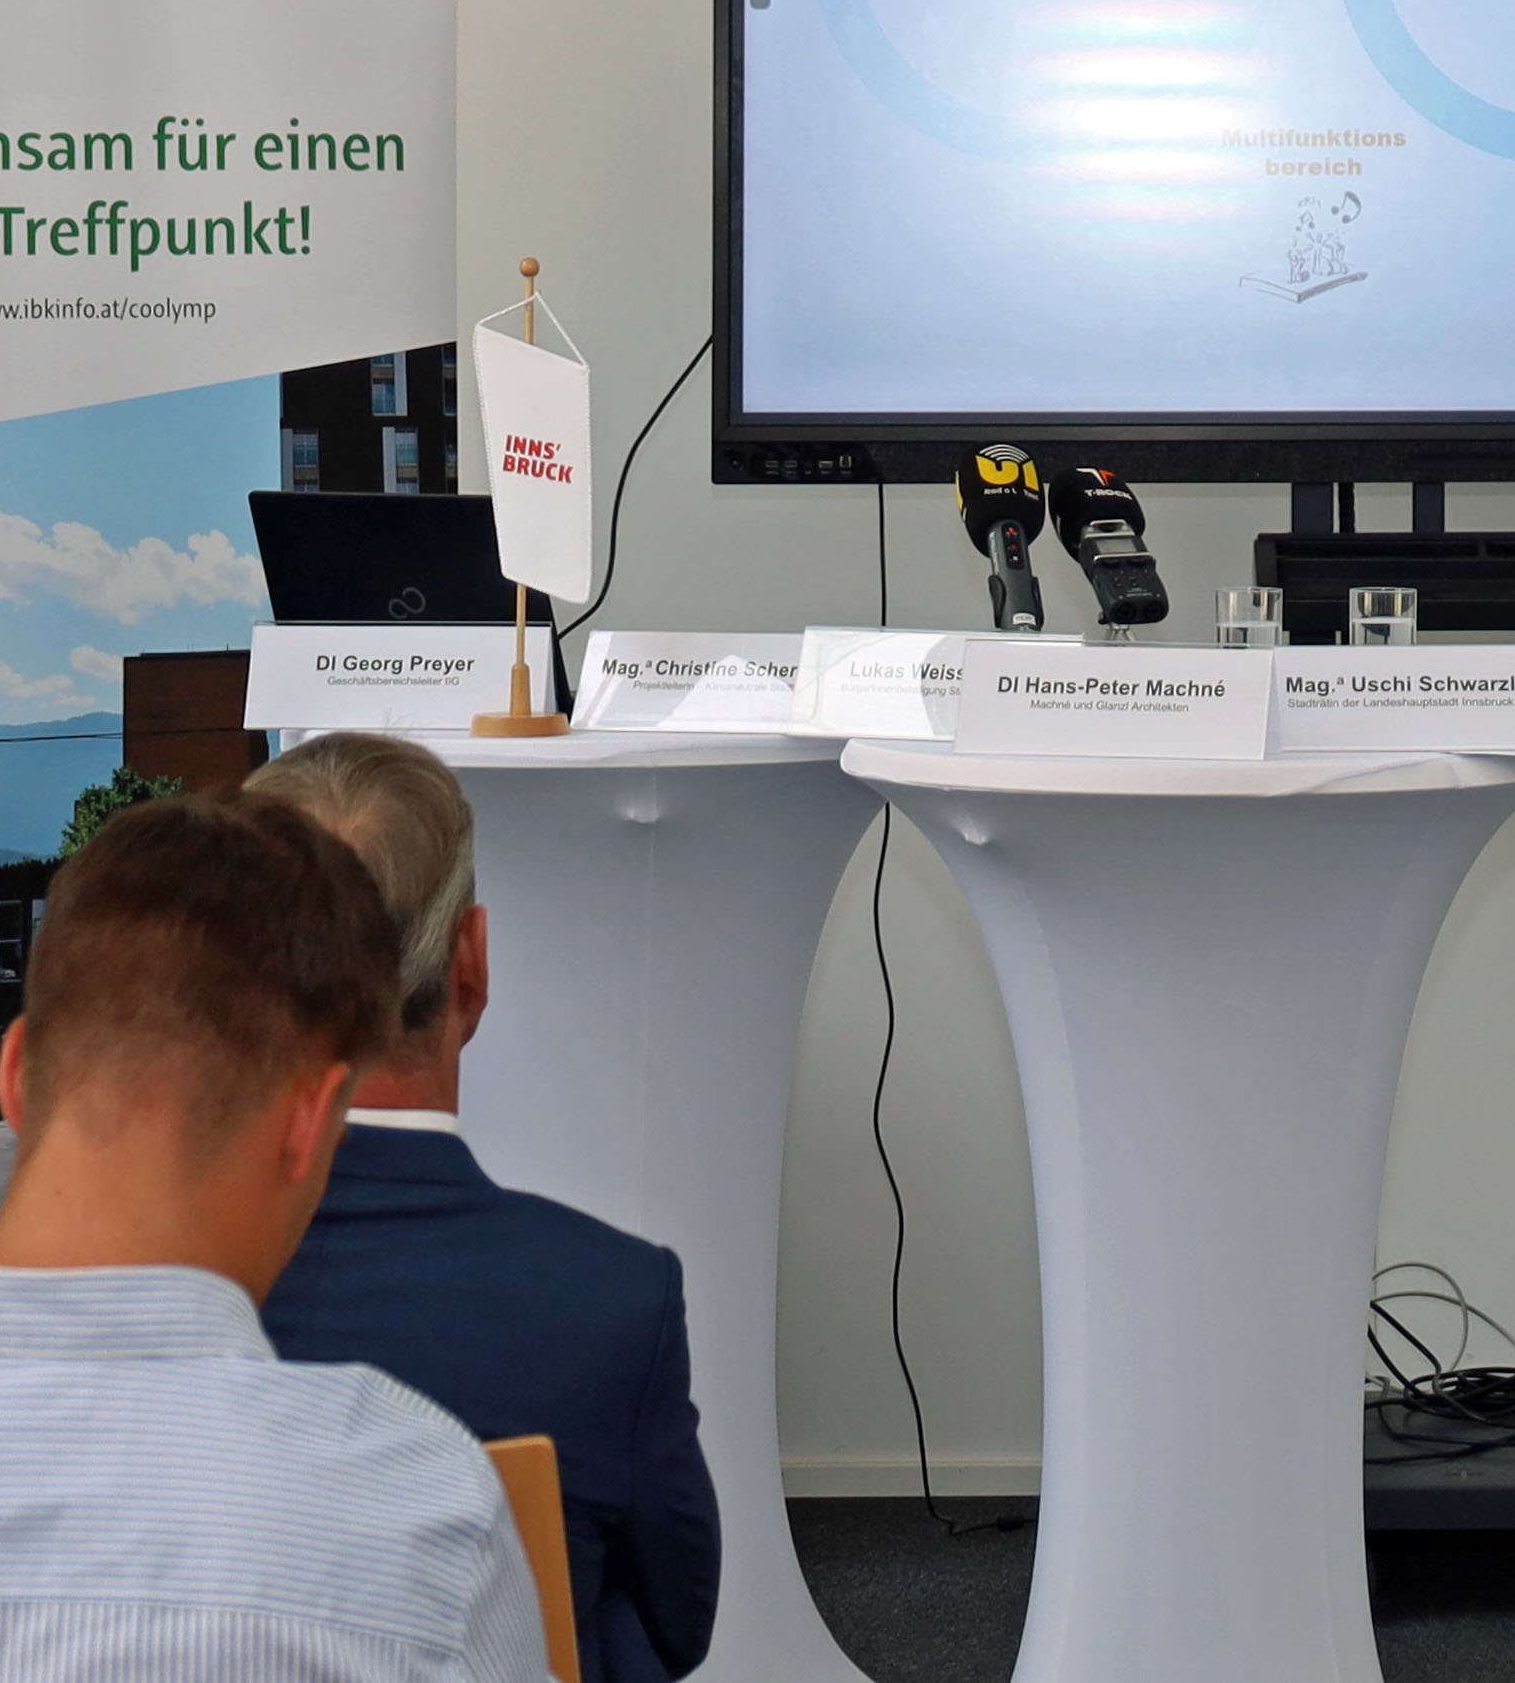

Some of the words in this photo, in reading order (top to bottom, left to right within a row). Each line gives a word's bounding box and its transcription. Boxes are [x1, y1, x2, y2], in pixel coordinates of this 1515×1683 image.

[152, 115, 237, 171] für
[253, 117, 406, 172] einen
[1219, 127, 1407, 147] Multifunktions
[1265, 157, 1363, 176] bereich
[502, 454, 575, 485] BRUCK
[316, 655, 337, 672] DI
[342, 655, 404, 675] Georg
[409, 655, 476, 675] Preyer
[655, 659, 738, 677] Christine
[849, 661, 905, 679] Lukas
[997, 676, 1019, 693] DI
[1025, 676, 1140, 696] Hans-Peter
[1145, 678, 1226, 698] Machné
[1351, 676, 1412, 692] Uschi
[1418, 675, 1515, 692] Schwarzl
[1030, 699, 1072, 710] Machné
[1073, 700, 1094, 710] und
[1131, 702, 1189, 713] Architekten
[1287, 697, 1340, 708] Stadträtin
[1341, 698, 1360, 708] der
[1362, 697, 1460, 709] Landeshauptstadt
[1461, 697, 1515, 707] Innsbruck
